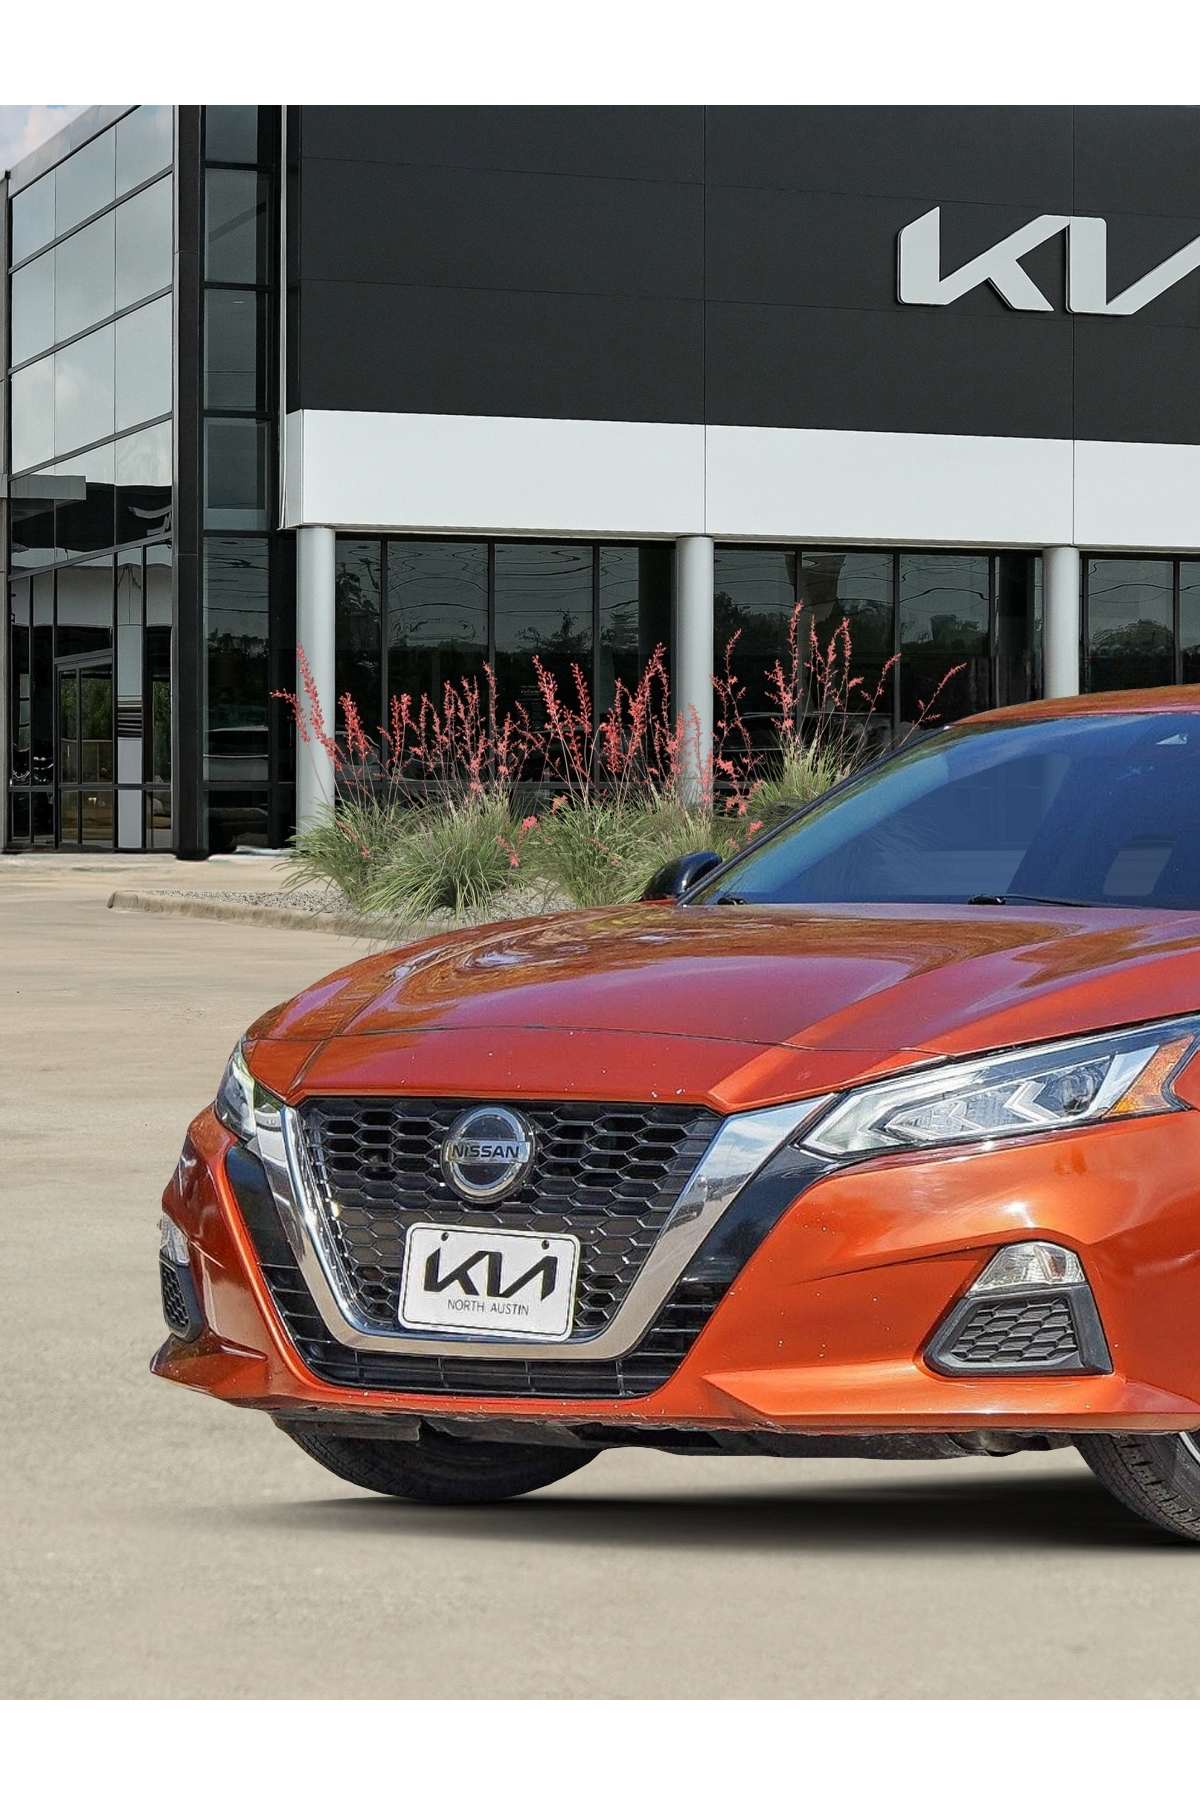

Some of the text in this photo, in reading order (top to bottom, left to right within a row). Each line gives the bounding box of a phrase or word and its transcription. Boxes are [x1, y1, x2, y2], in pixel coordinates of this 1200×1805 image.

[451, 1144, 520, 1159] NISSAN
[423, 1247, 559, 1302] KIA
[447, 1299, 529, 1316] NORTH AUSTIN
